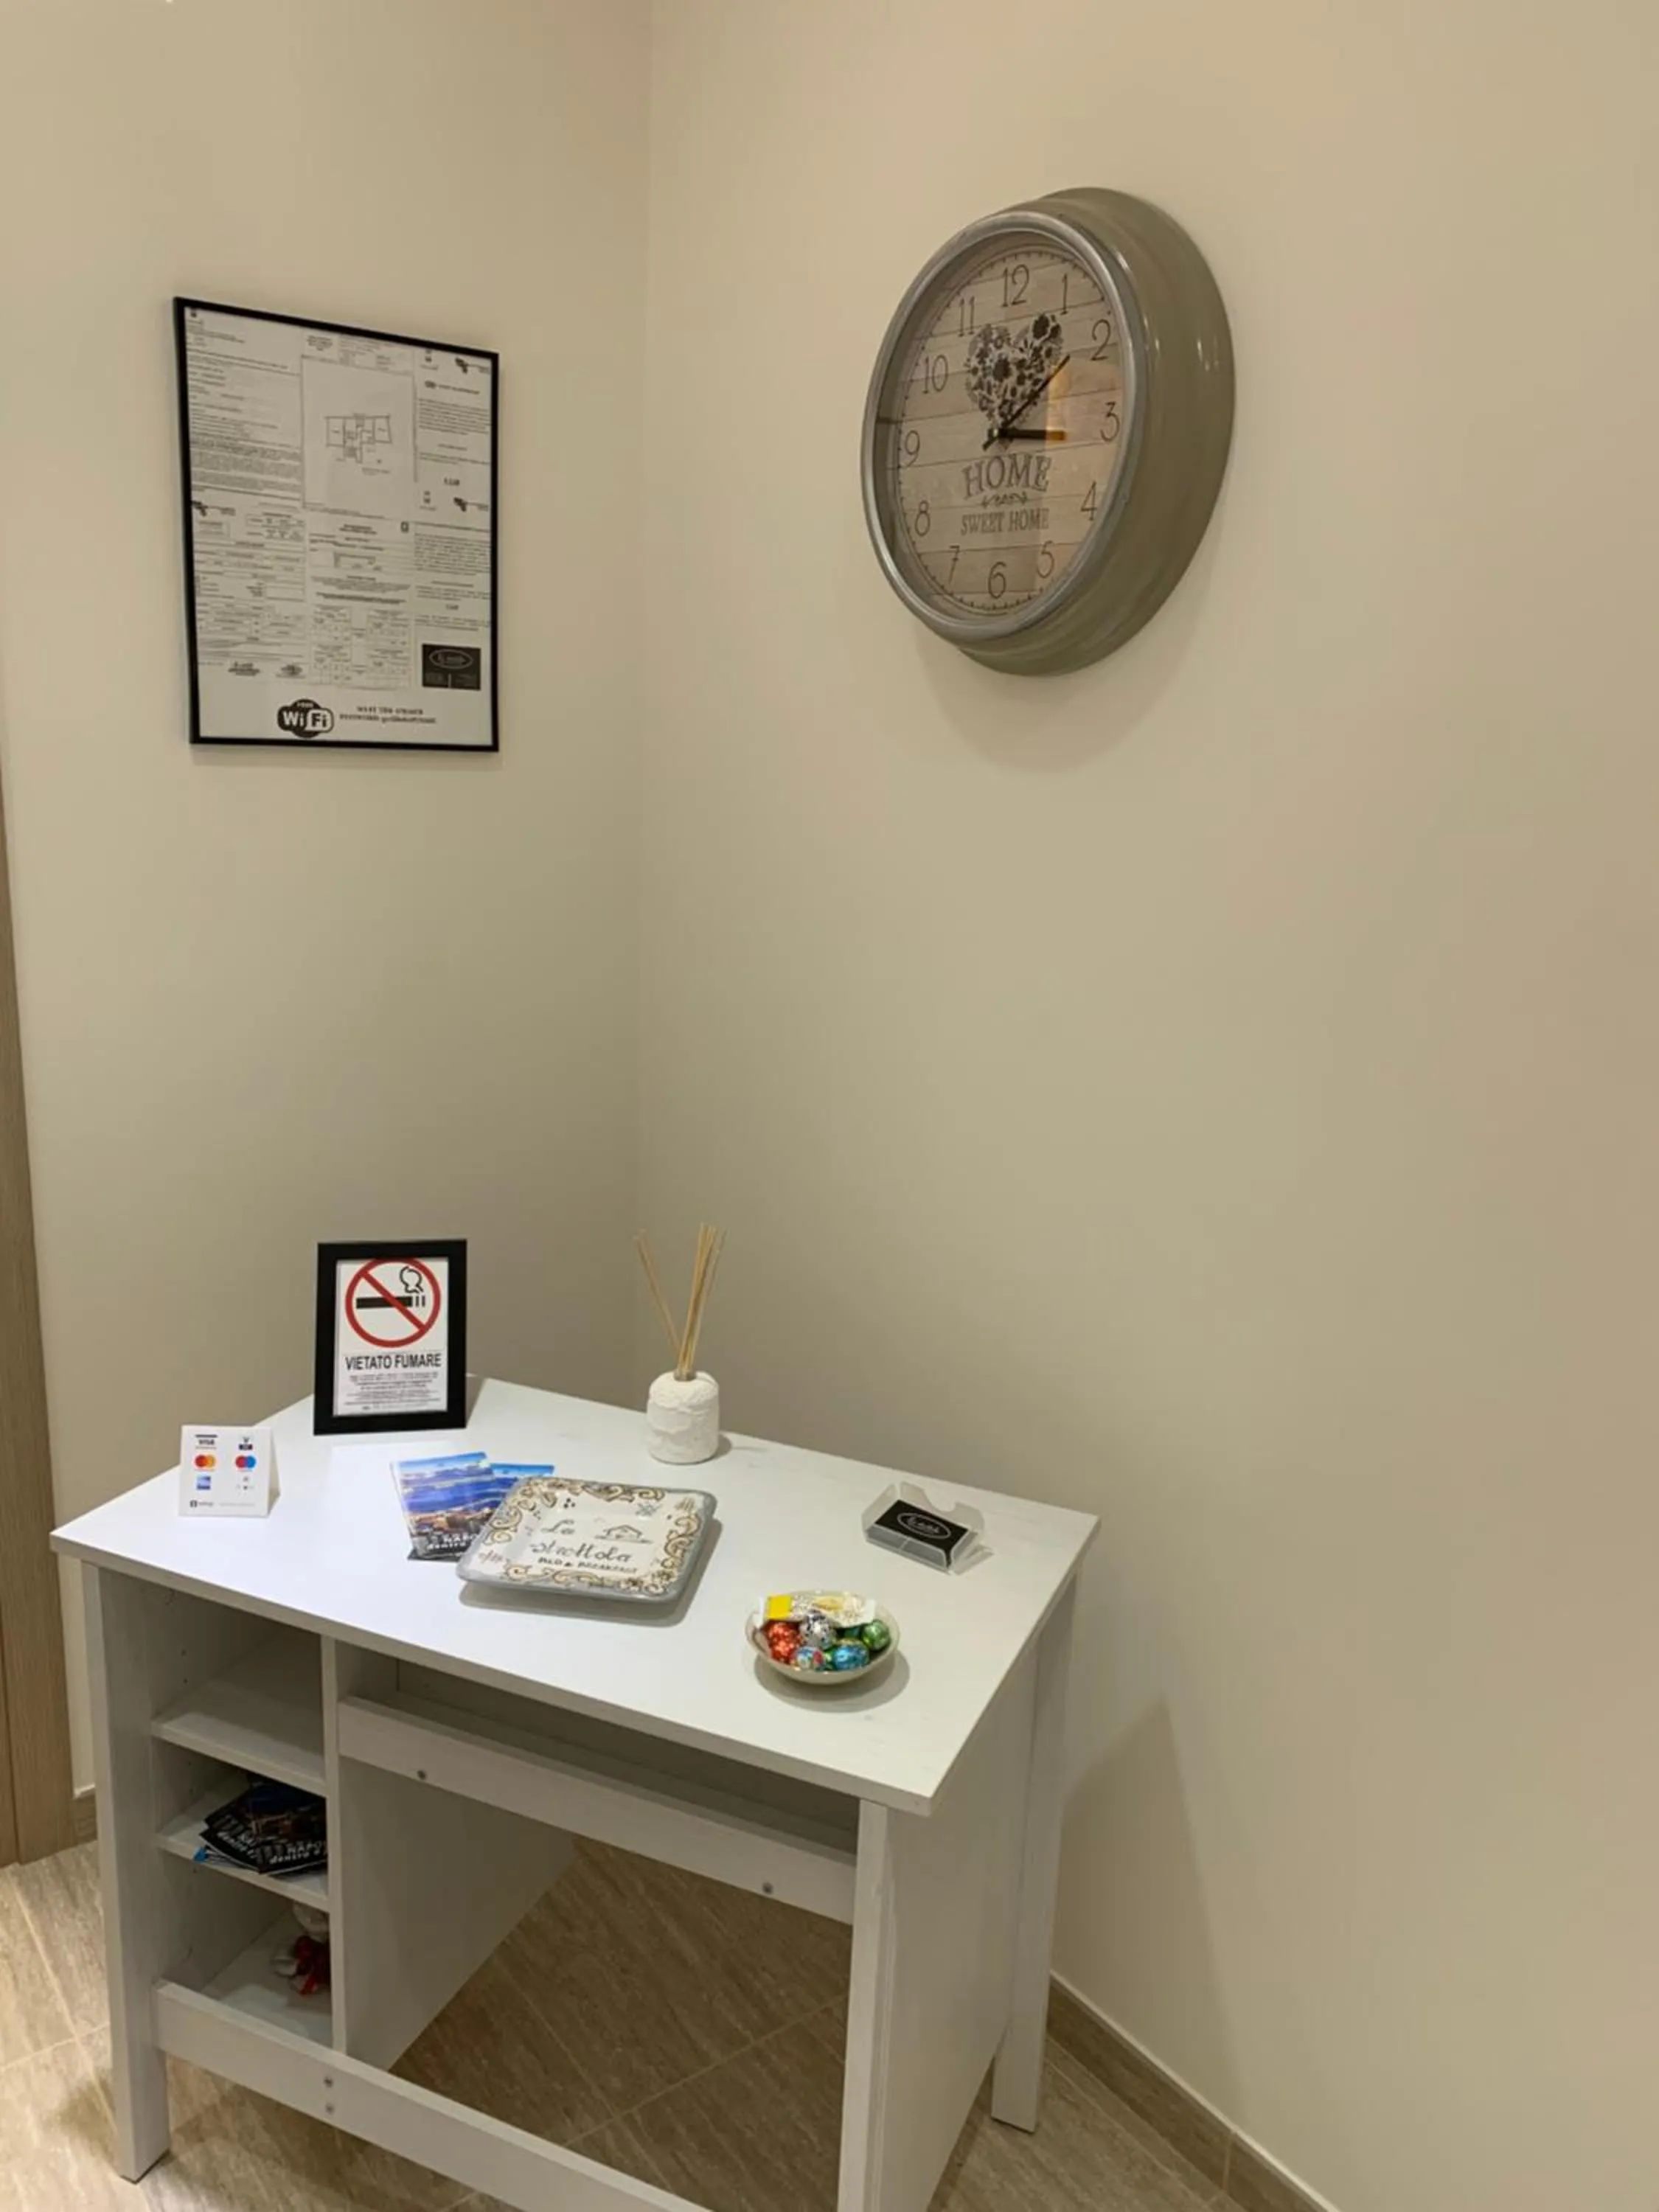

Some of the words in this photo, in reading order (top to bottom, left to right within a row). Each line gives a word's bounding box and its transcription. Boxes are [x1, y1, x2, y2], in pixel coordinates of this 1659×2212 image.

[1001, 263, 1030, 307] 12
[1059, 273, 1068, 316] 1
[958, 296, 975, 337] 11
[1091, 319, 1111, 361] 2
[922, 354, 949, 394] 10
[1100, 401, 1121, 442] 3
[904, 430, 921, 467] 9
[961, 453, 1052, 501] HOME
[914, 500, 931, 537] 8
[961, 511, 1005, 535] SWEET
[1008, 507, 1050, 532] HOME
[1080, 480, 1099, 521] 4
[947, 544, 961, 585] 7
[987, 560, 1006, 599] 6
[1035, 540, 1055, 579] 5
[344, 1355, 392, 1371] VIETATO
[394, 1352, 442, 1368] FUMARE
